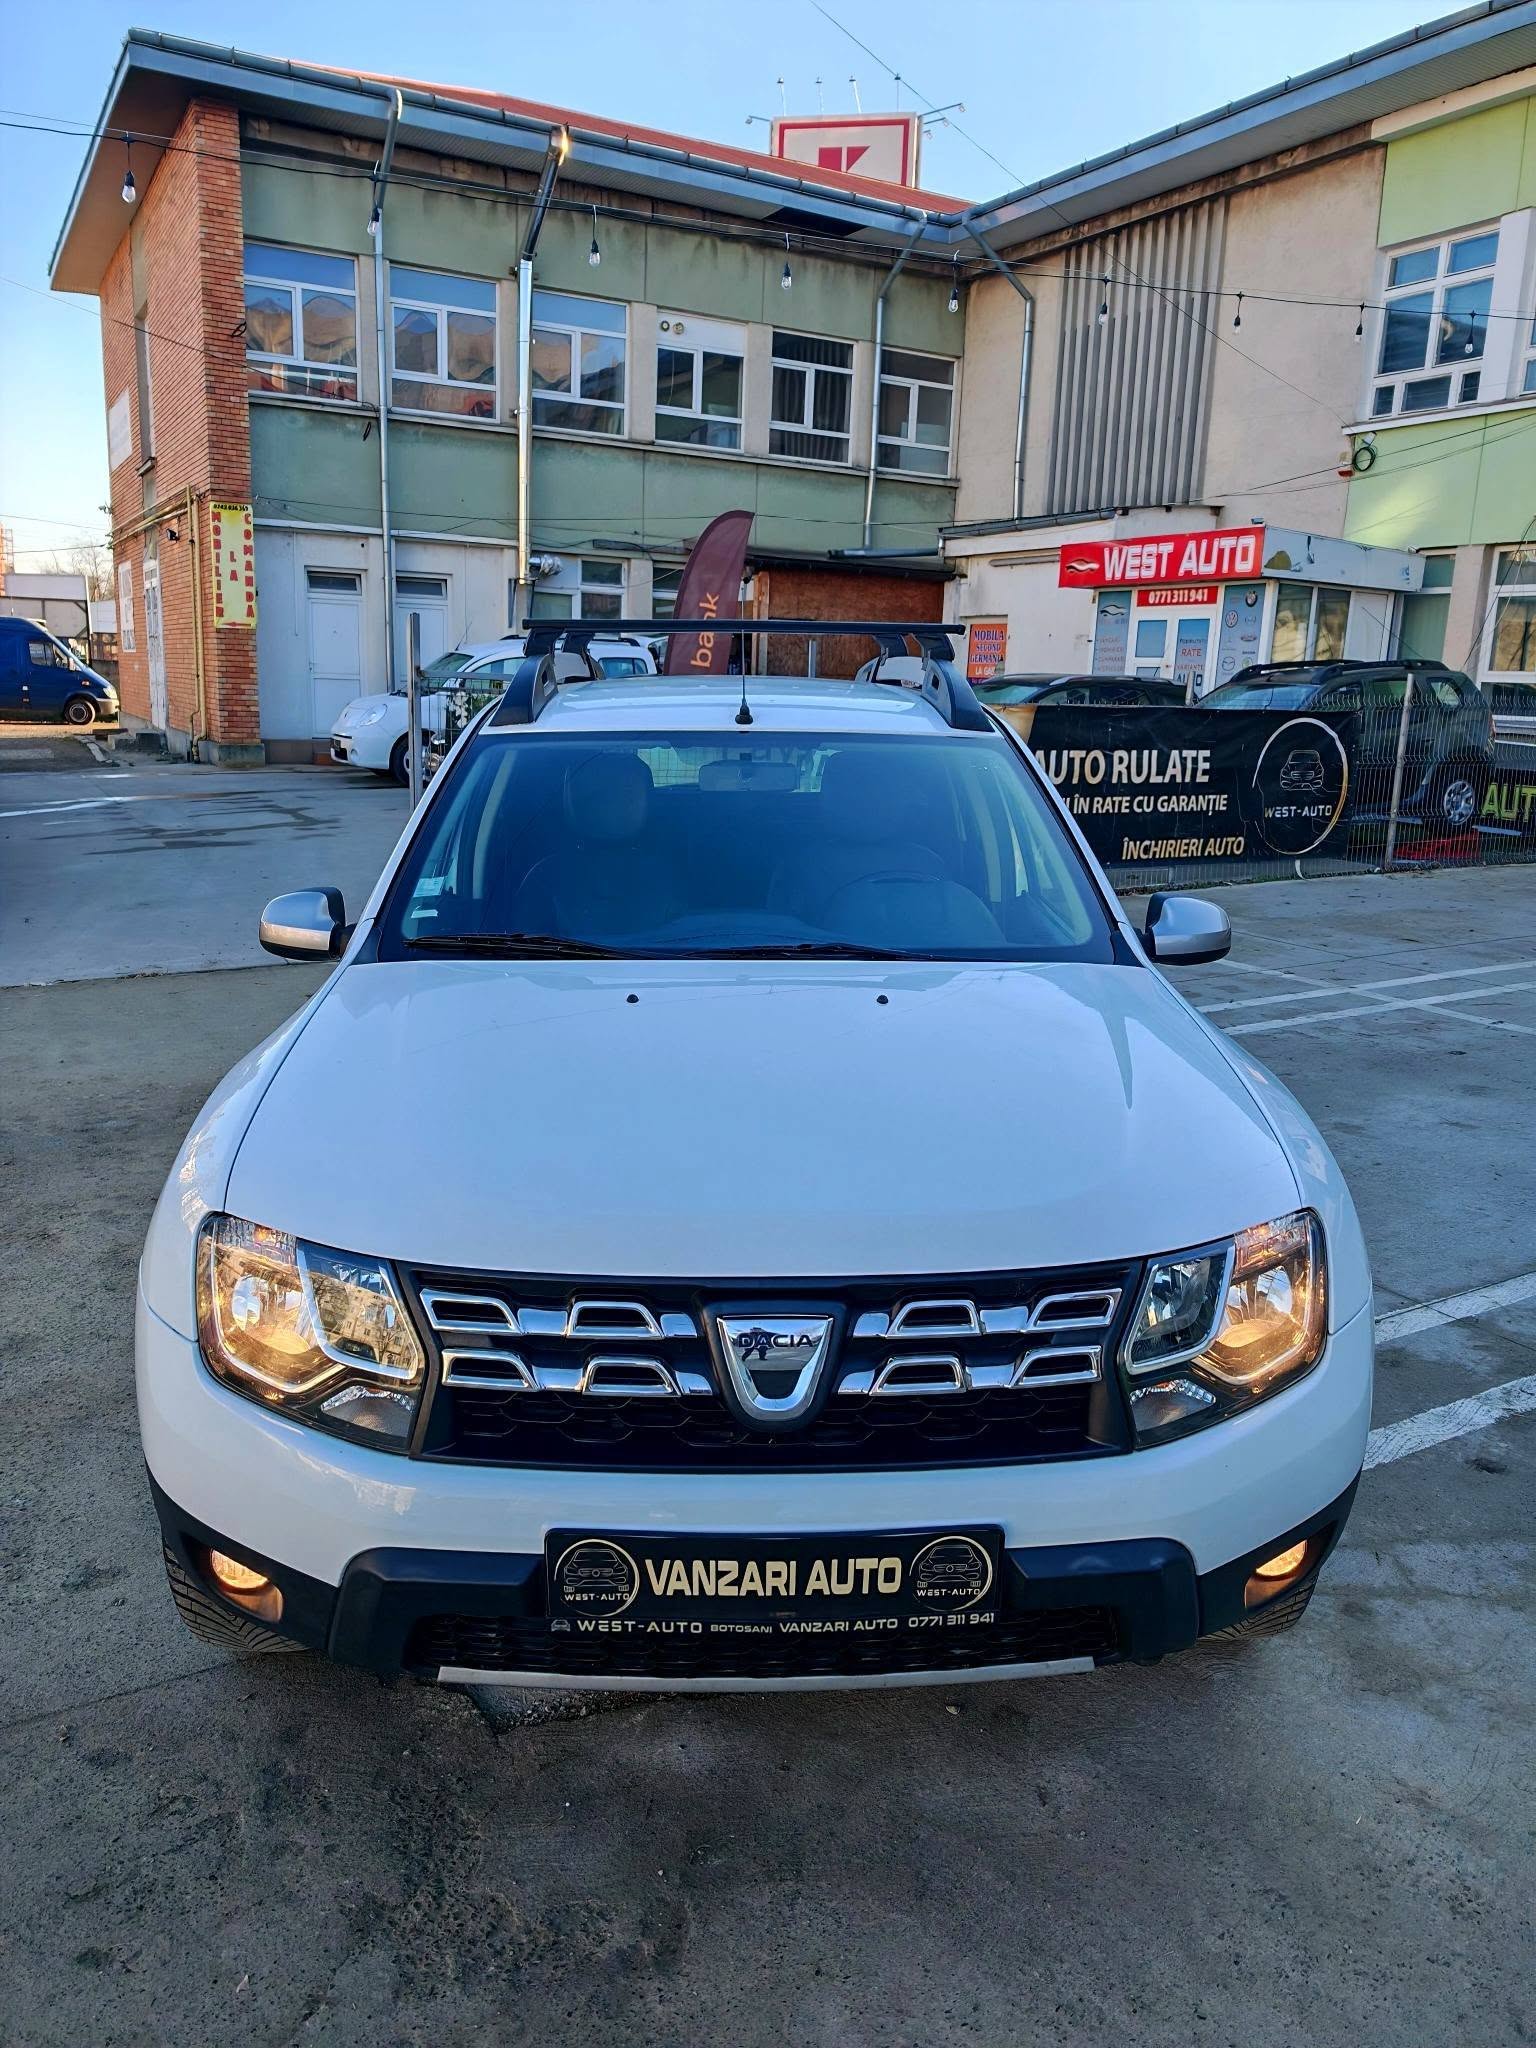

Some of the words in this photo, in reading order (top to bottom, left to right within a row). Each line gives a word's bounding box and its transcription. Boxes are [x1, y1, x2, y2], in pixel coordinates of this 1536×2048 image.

[211, 511, 224, 618] MOBILIER
[1103, 542, 1174, 581] WEST
[1178, 535, 1256, 577] AUTO
[1181, 648, 1202, 657] RATE
[1111, 749, 1211, 784] RULATE
[1073, 793, 1090, 814] ÎN
[1092, 796, 1130, 814] RATE
[1133, 795, 1154, 813] CU
[1264, 804, 1333, 818] WEST-AUTO
[1121, 837, 1203, 860] ÎNCHIRIERI
[1204, 836, 1245, 857] AUTO
[737, 1334, 814, 1348] DACIA
[644, 1559, 797, 1597] VANZARI
[804, 1557, 902, 1596] AUTO
[564, 1593, 630, 1601] WEST-AUTO
[916, 1588, 981, 1597] WEST-AUTO
[577, 1619, 703, 1634] WEST-AUTO
[710, 1624, 773, 1633] BOTOSANI
[779, 1621, 849, 1633] VANZARI
[853, 1618, 899, 1631] AUTO
[908, 1616, 943, 1628] 0771
[947, 1614, 965, 1625] 311
[969, 1612, 995, 1624] 941
